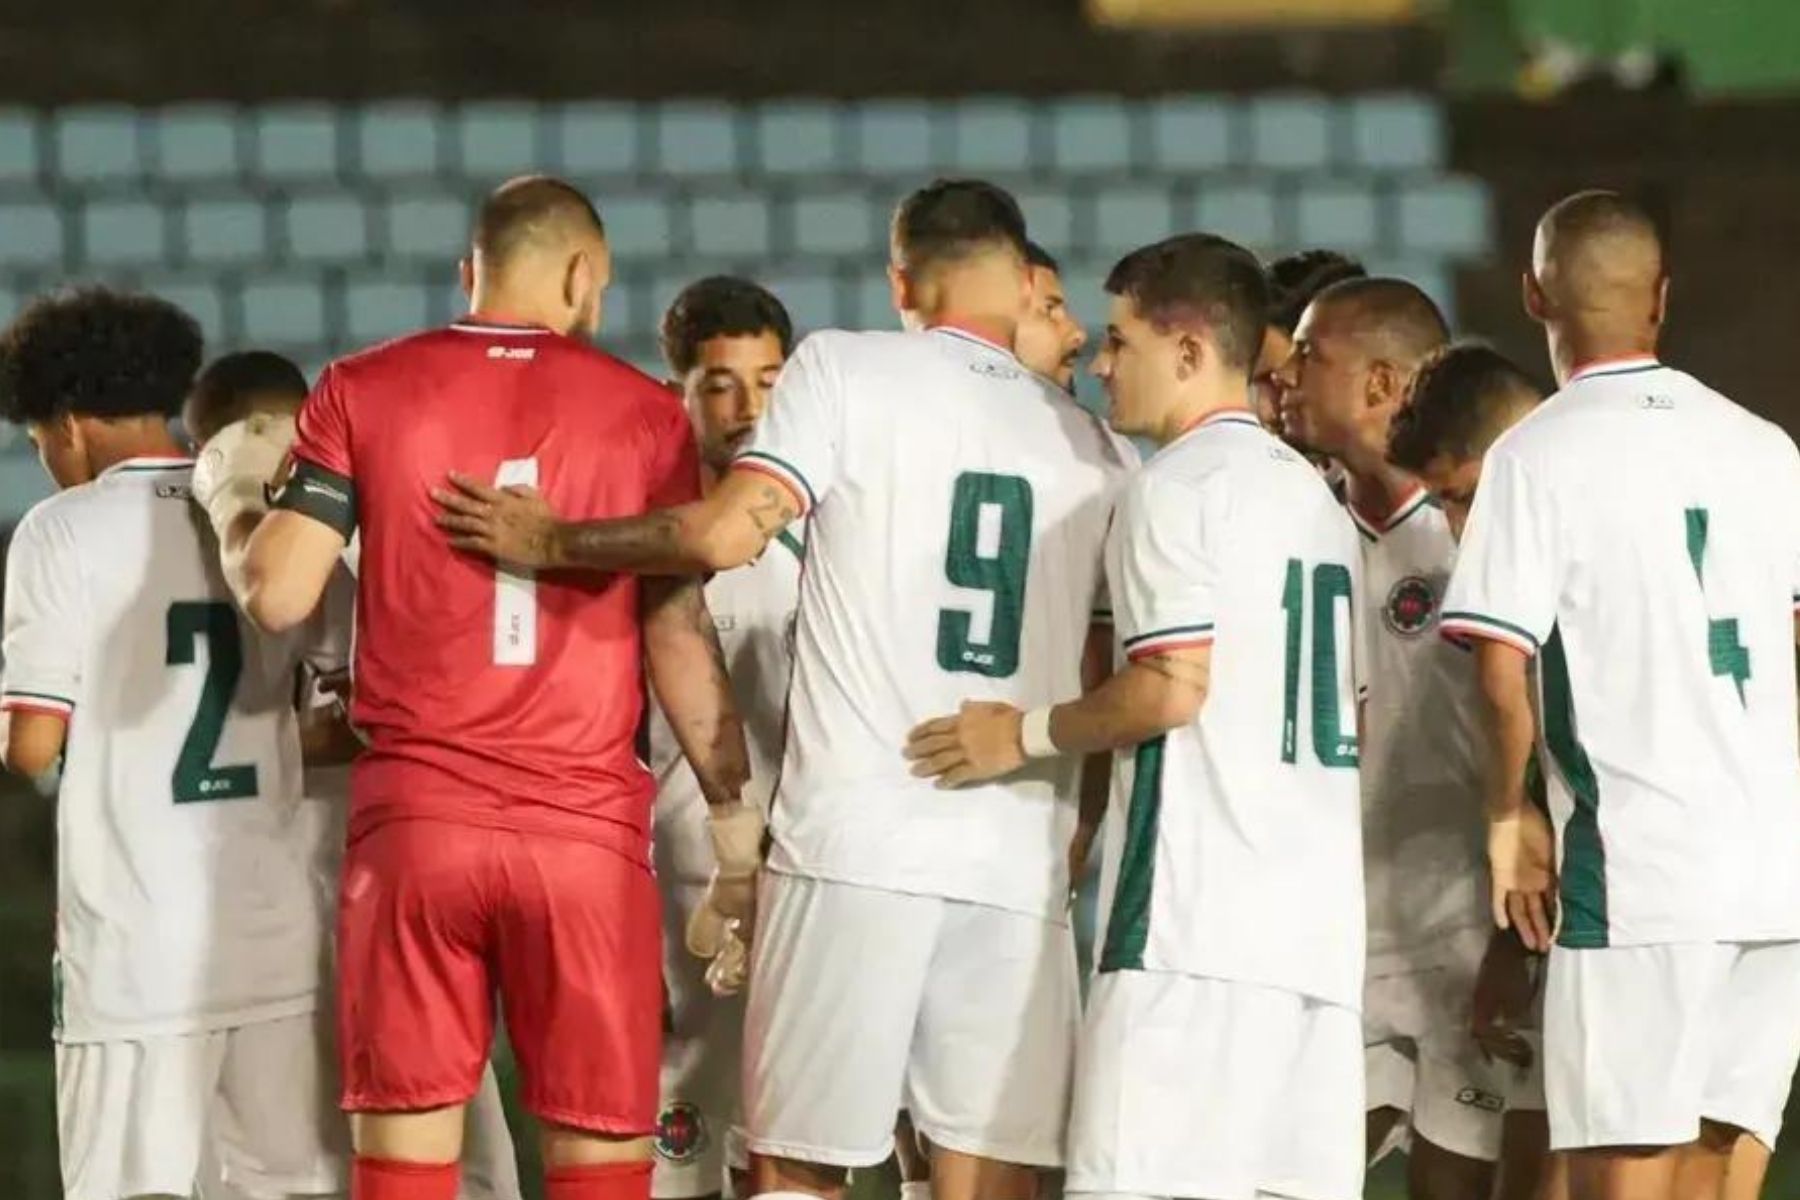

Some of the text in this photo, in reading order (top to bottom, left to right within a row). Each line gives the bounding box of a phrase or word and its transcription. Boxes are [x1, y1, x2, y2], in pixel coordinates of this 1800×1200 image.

[494, 457, 538, 666] 1
[937, 471, 1033, 678] 9
[1281, 557, 1360, 768] 10
[1684, 507, 1752, 711] 4
[166, 602, 259, 804] 2
